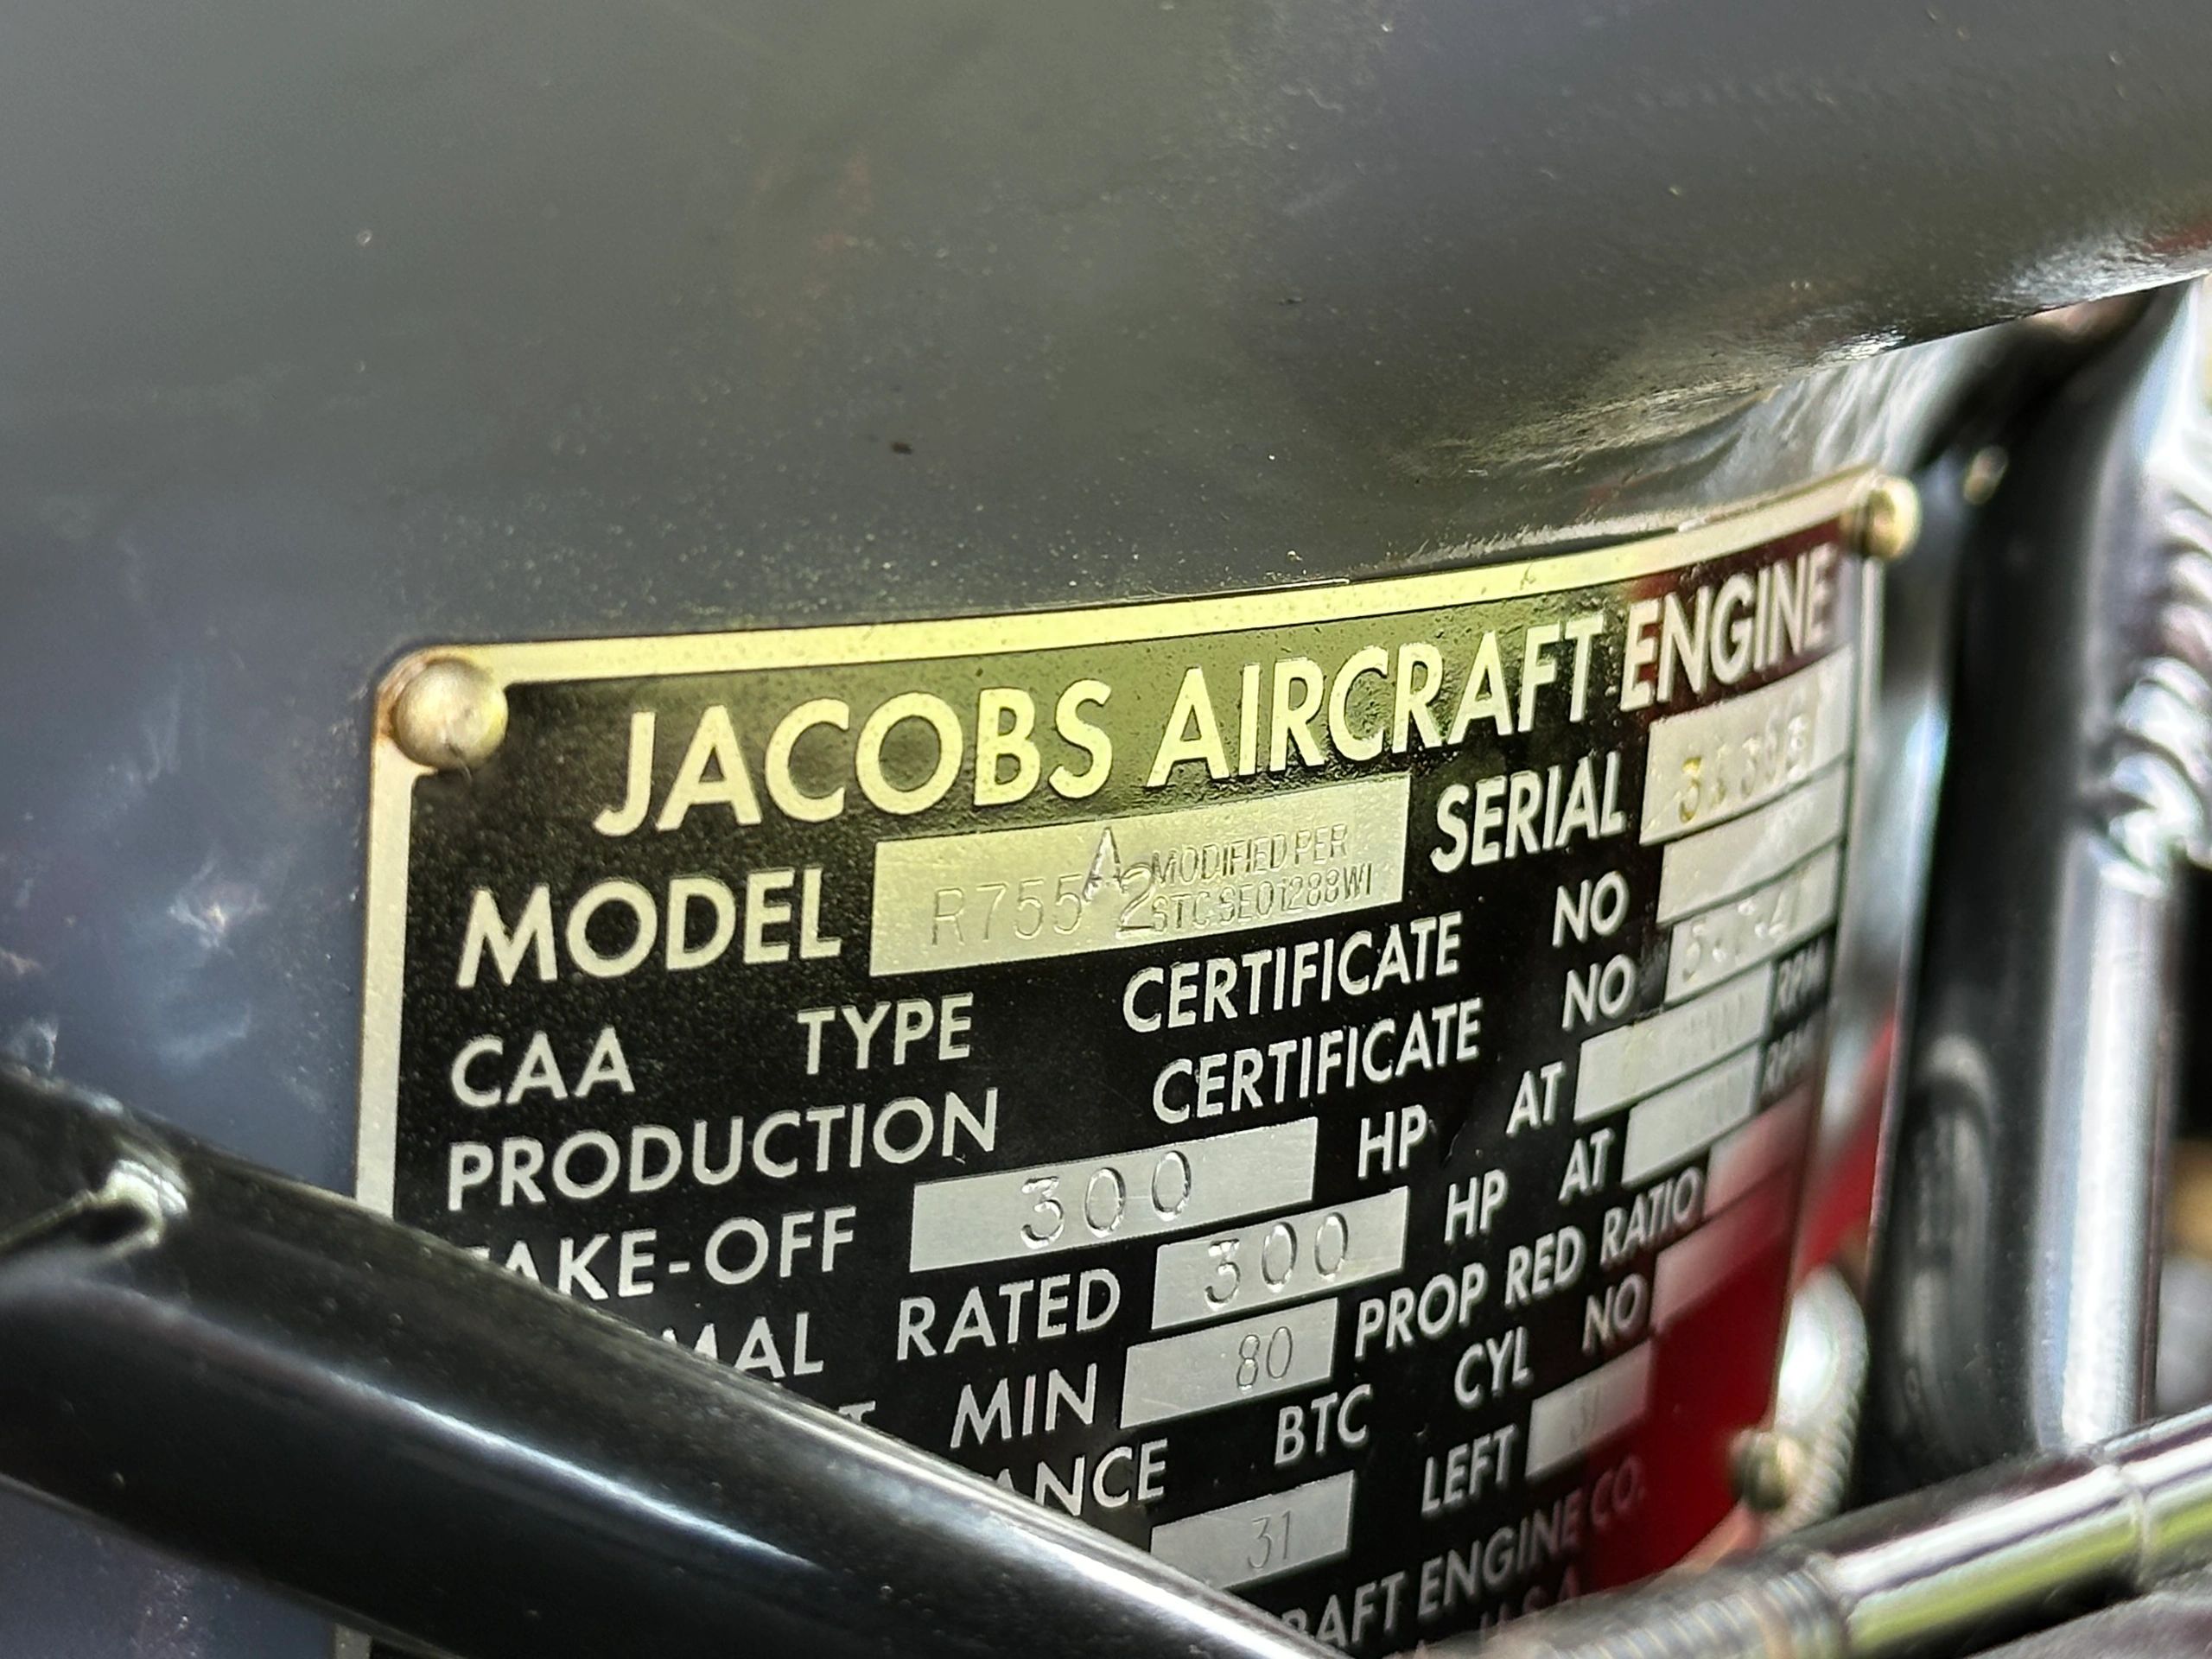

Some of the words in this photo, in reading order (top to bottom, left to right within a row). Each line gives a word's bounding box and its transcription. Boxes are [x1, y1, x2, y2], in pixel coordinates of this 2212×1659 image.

[593, 679, 1114, 836] JACOBS
[1146, 610, 1607, 788] AIRCRAFT
[1620, 543, 1839, 712] ENGINE
[456, 867, 843, 989] MODEL
[1294, 821, 1350, 867] PER
[1430, 750, 1627, 874] SERIAL
[448, 1087, 1000, 1211] PRODUCTION
[1152, 996, 1484, 1126] CERTIFICATE
[1562, 952, 1638, 1031] NO
[449, 1026, 637, 1109] CAA
[797, 992, 975, 1075] TYPE
[1122, 910, 1464, 1033] CERTIFICATE
[1552, 870, 1631, 948] NO
[464, 1205, 858, 1300] AKE-OFF
[1020, 1147, 1193, 1251] 300
[1357, 1103, 1431, 1179] HP
[1506, 1060, 1568, 1135] AT
[662, 1311, 824, 1380] AL
[895, 1268, 1122, 1362] RATED
[1203, 1210, 1349, 1313] 300
[1444, 1168, 1510, 1244] HP
[1559, 1128, 1616, 1204] AT
[950, 1363, 1097, 1449] MIN
[1236, 1325, 1294, 1392] 80
[1354, 1260, 1484, 1361] PROP
[1504, 1225, 1588, 1310] RED
[1599, 1168, 1707, 1270] RATIO
[994, 1439, 1168, 1517] NCE
[1274, 1384, 1374, 1467] BTC
[1454, 1325, 1535, 1408] CYL
[1581, 1272, 1649, 1357] NO
[1246, 1510, 1293, 1569] 31
[1421, 1423, 1517, 1518] LEFT
[1417, 1486, 1585, 1619] ENGINE
